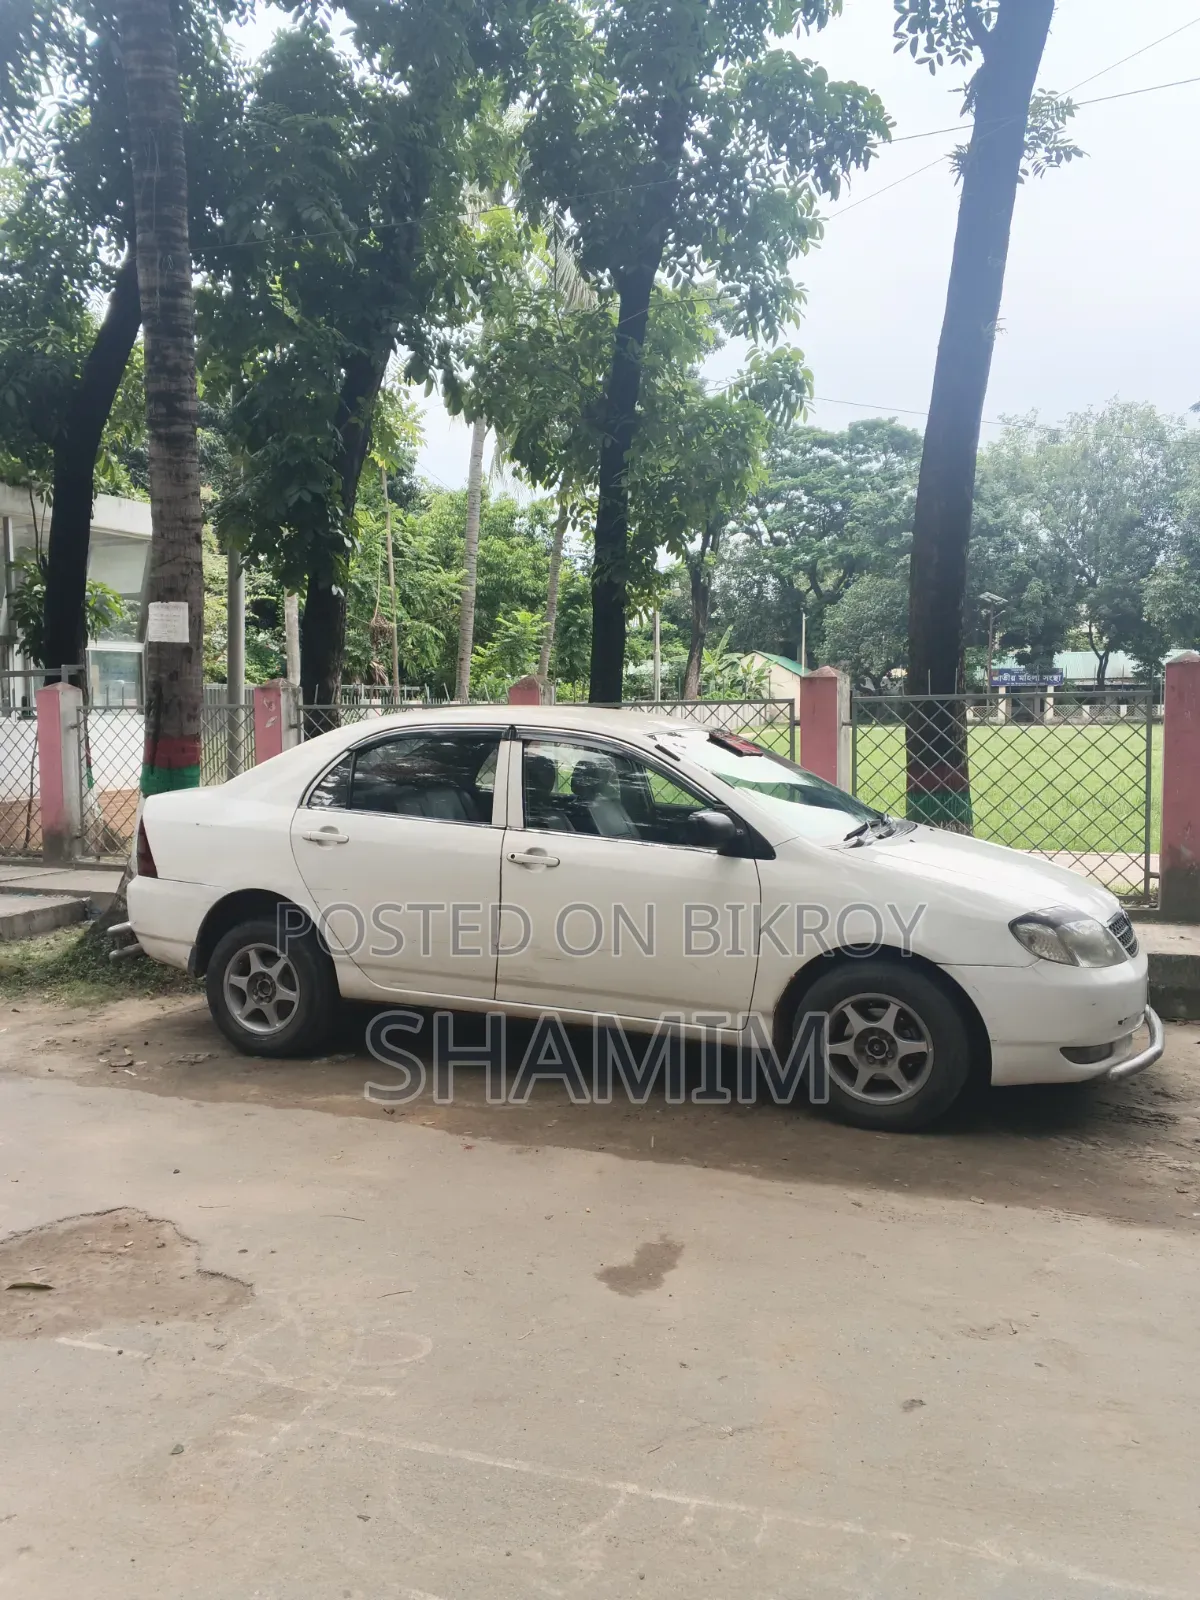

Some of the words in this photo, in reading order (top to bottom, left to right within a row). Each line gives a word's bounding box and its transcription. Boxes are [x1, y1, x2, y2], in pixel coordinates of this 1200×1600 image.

[992, 673, 1016, 682] জাতীয়
[1018, 673, 1040, 682] মহিলা
[1042, 674, 1062, 683] সংস্থা
